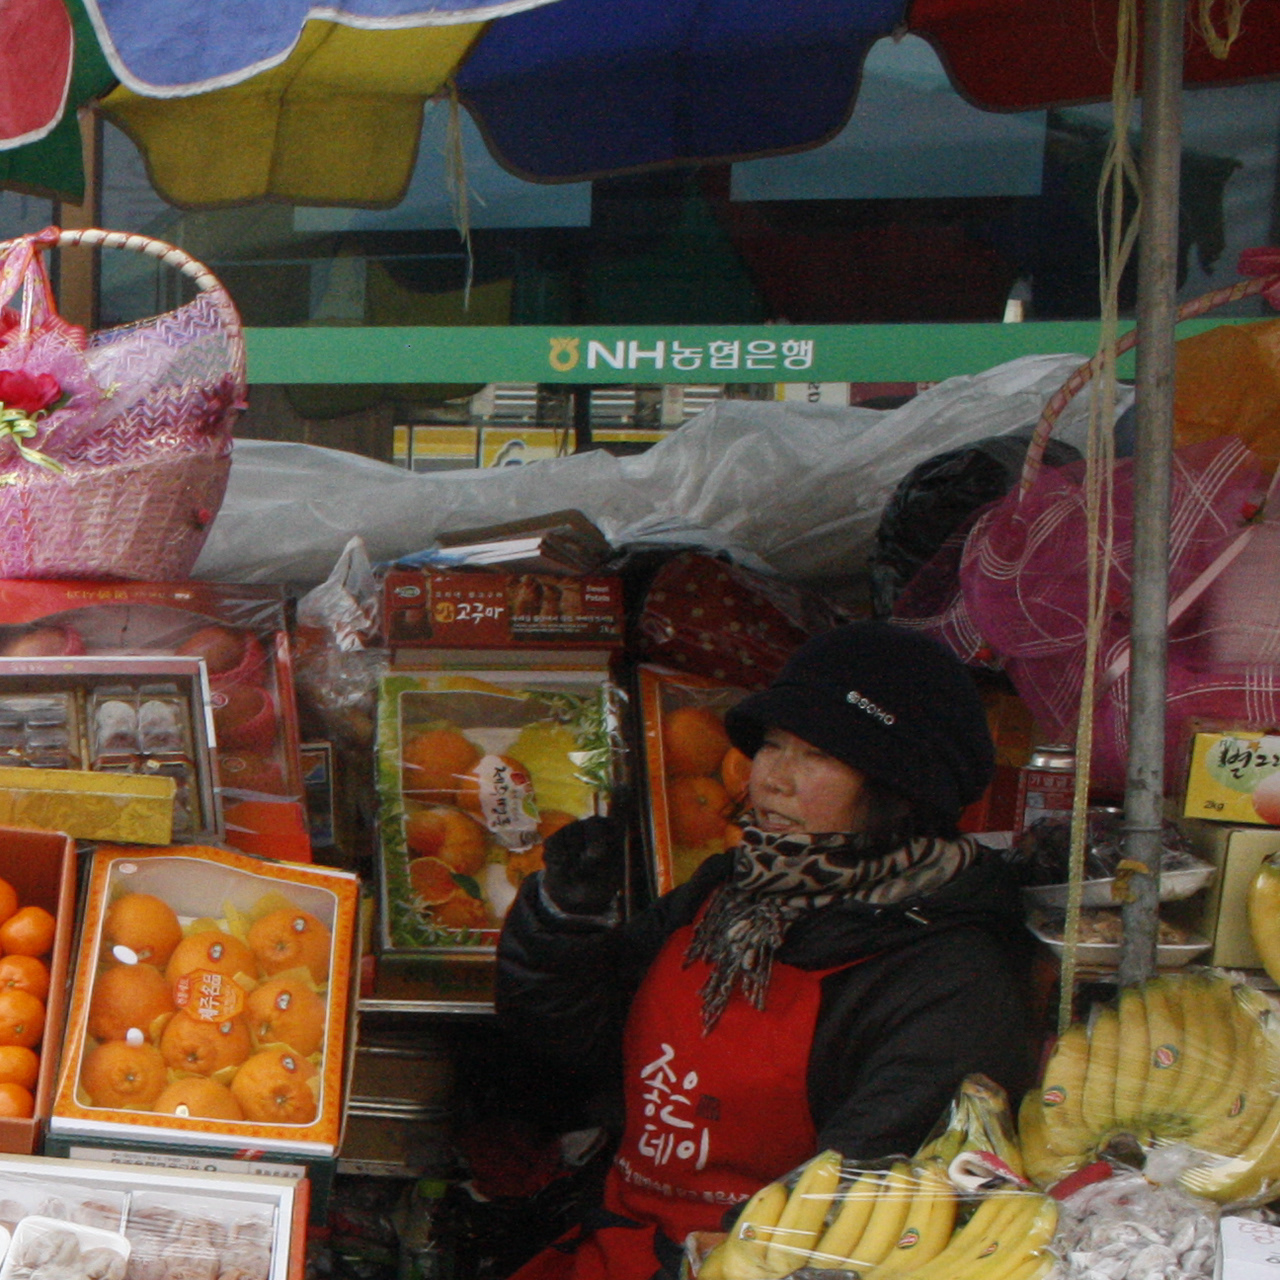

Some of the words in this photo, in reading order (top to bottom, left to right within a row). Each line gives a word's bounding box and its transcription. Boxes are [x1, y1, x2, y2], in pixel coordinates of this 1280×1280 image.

[587, 339, 814, 371] NH농협은행
[456, 603, 505, 625] 고구마
[1203, 799, 1226, 813] 2kg
